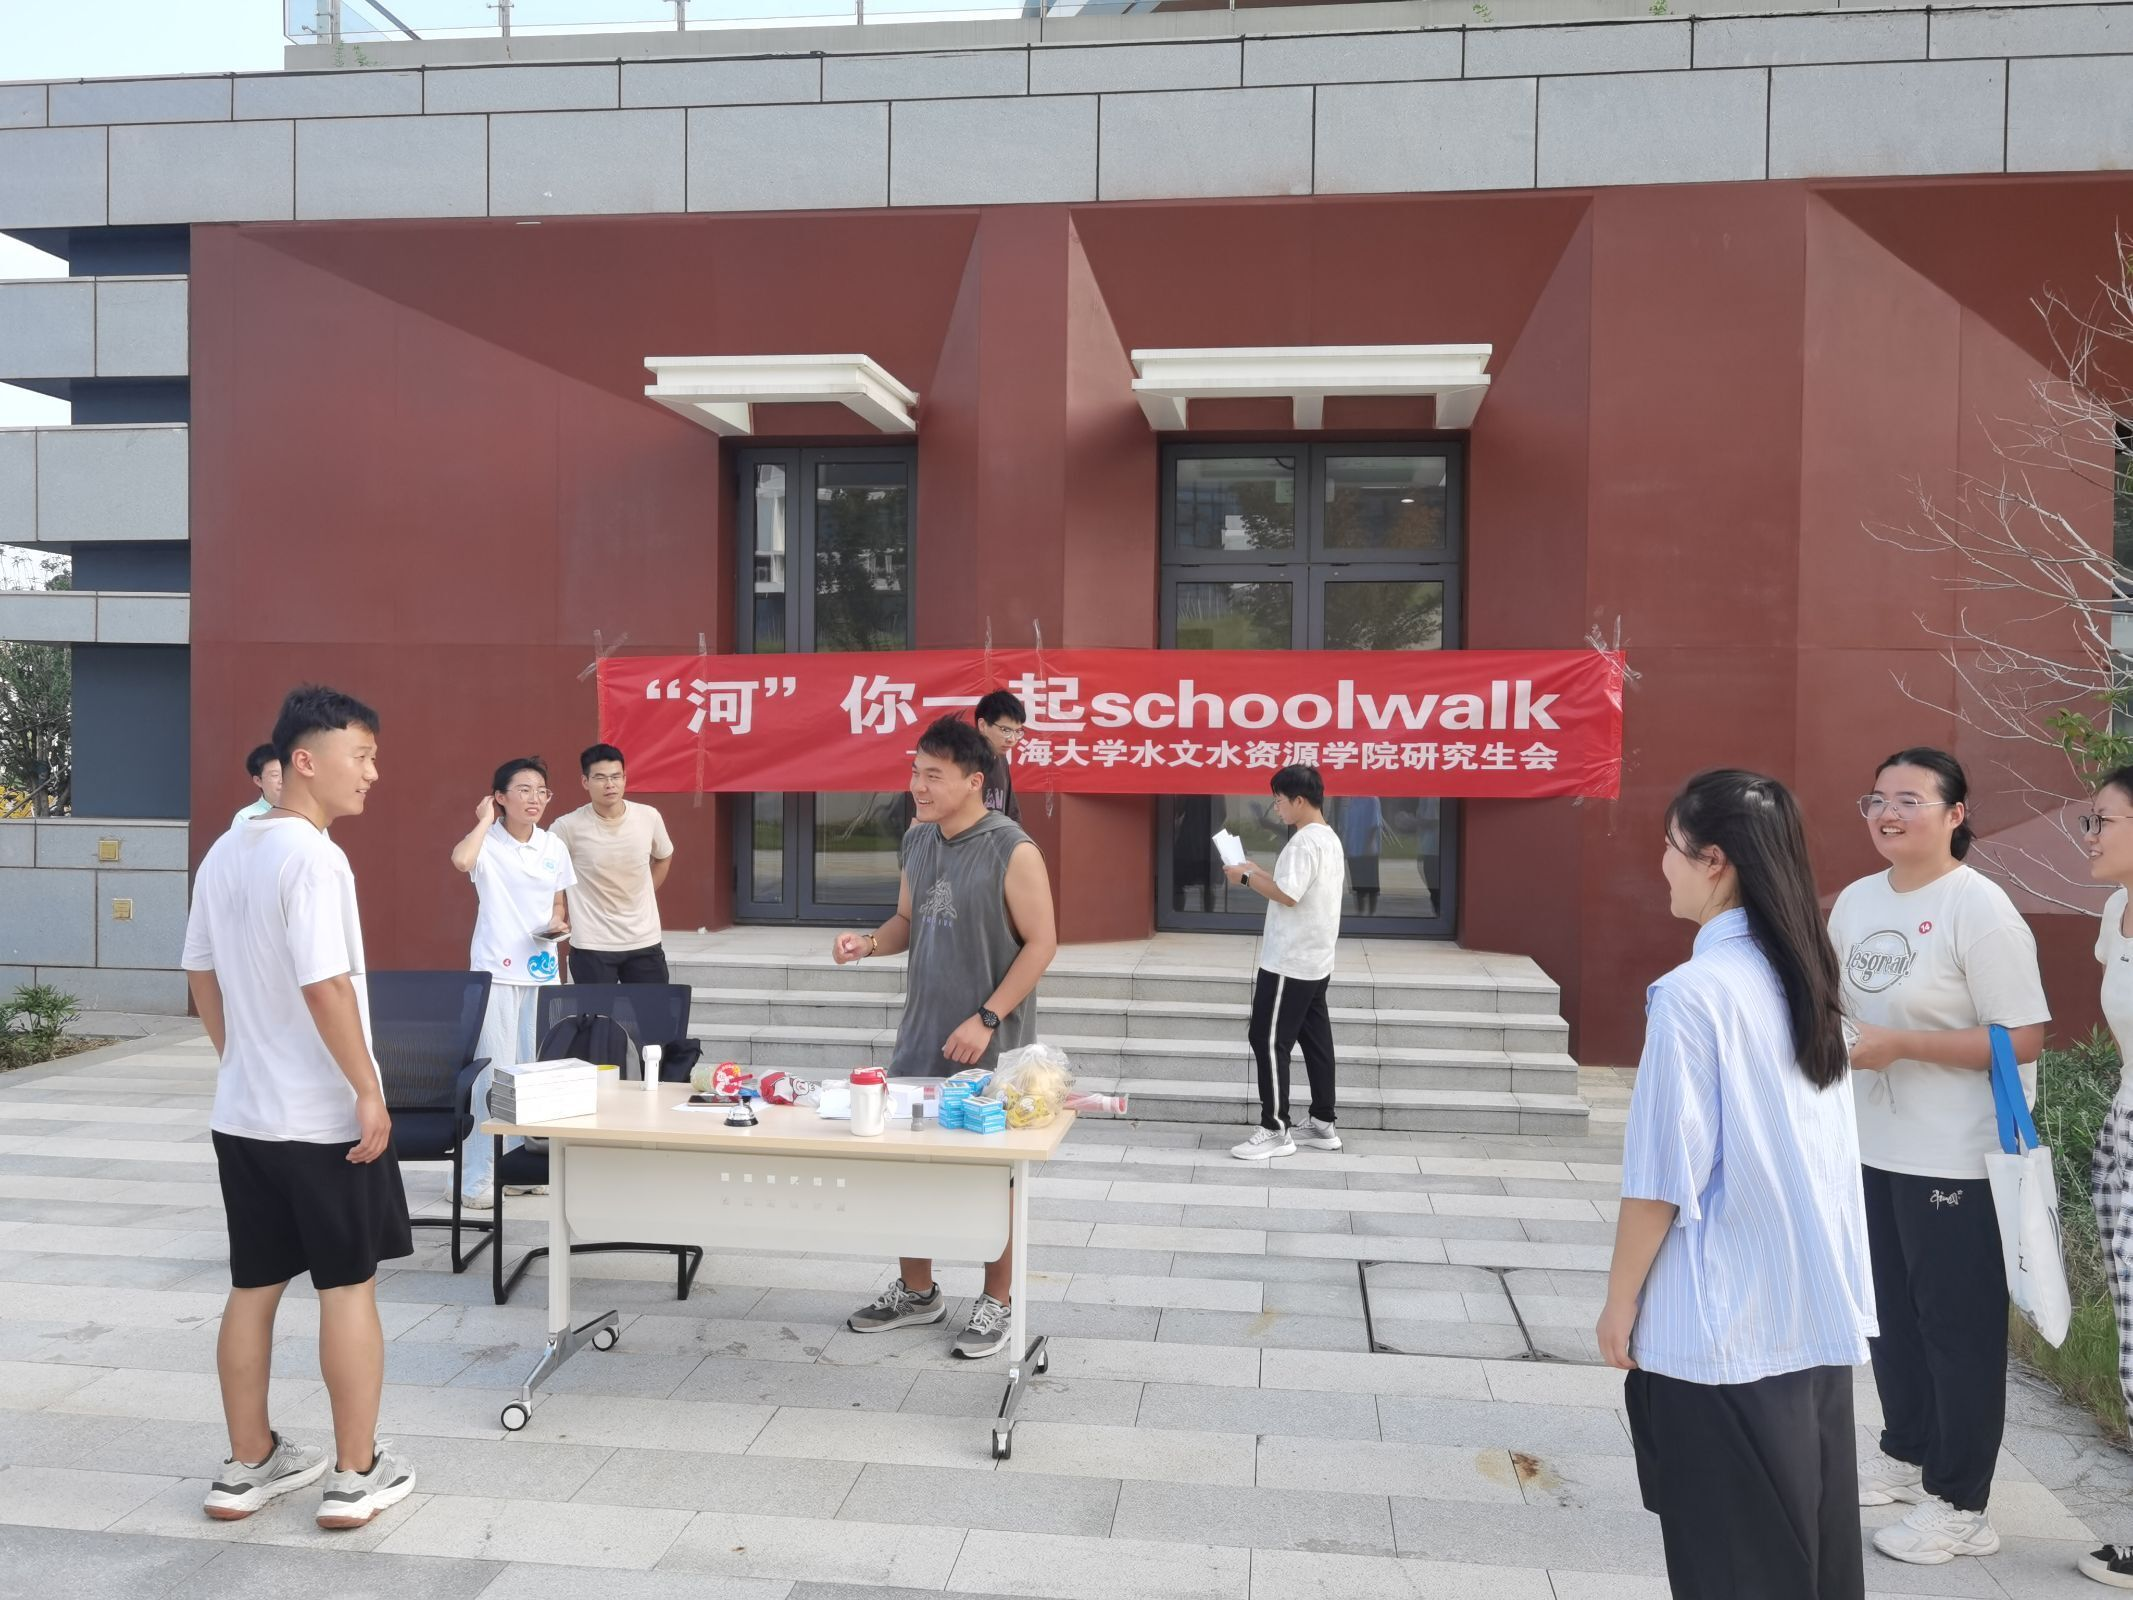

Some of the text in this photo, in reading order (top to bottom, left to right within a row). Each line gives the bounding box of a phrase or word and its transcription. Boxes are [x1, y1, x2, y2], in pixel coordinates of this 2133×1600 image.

[1006, 738, 1559, 771] 海大学水文水资源学院研究生会
